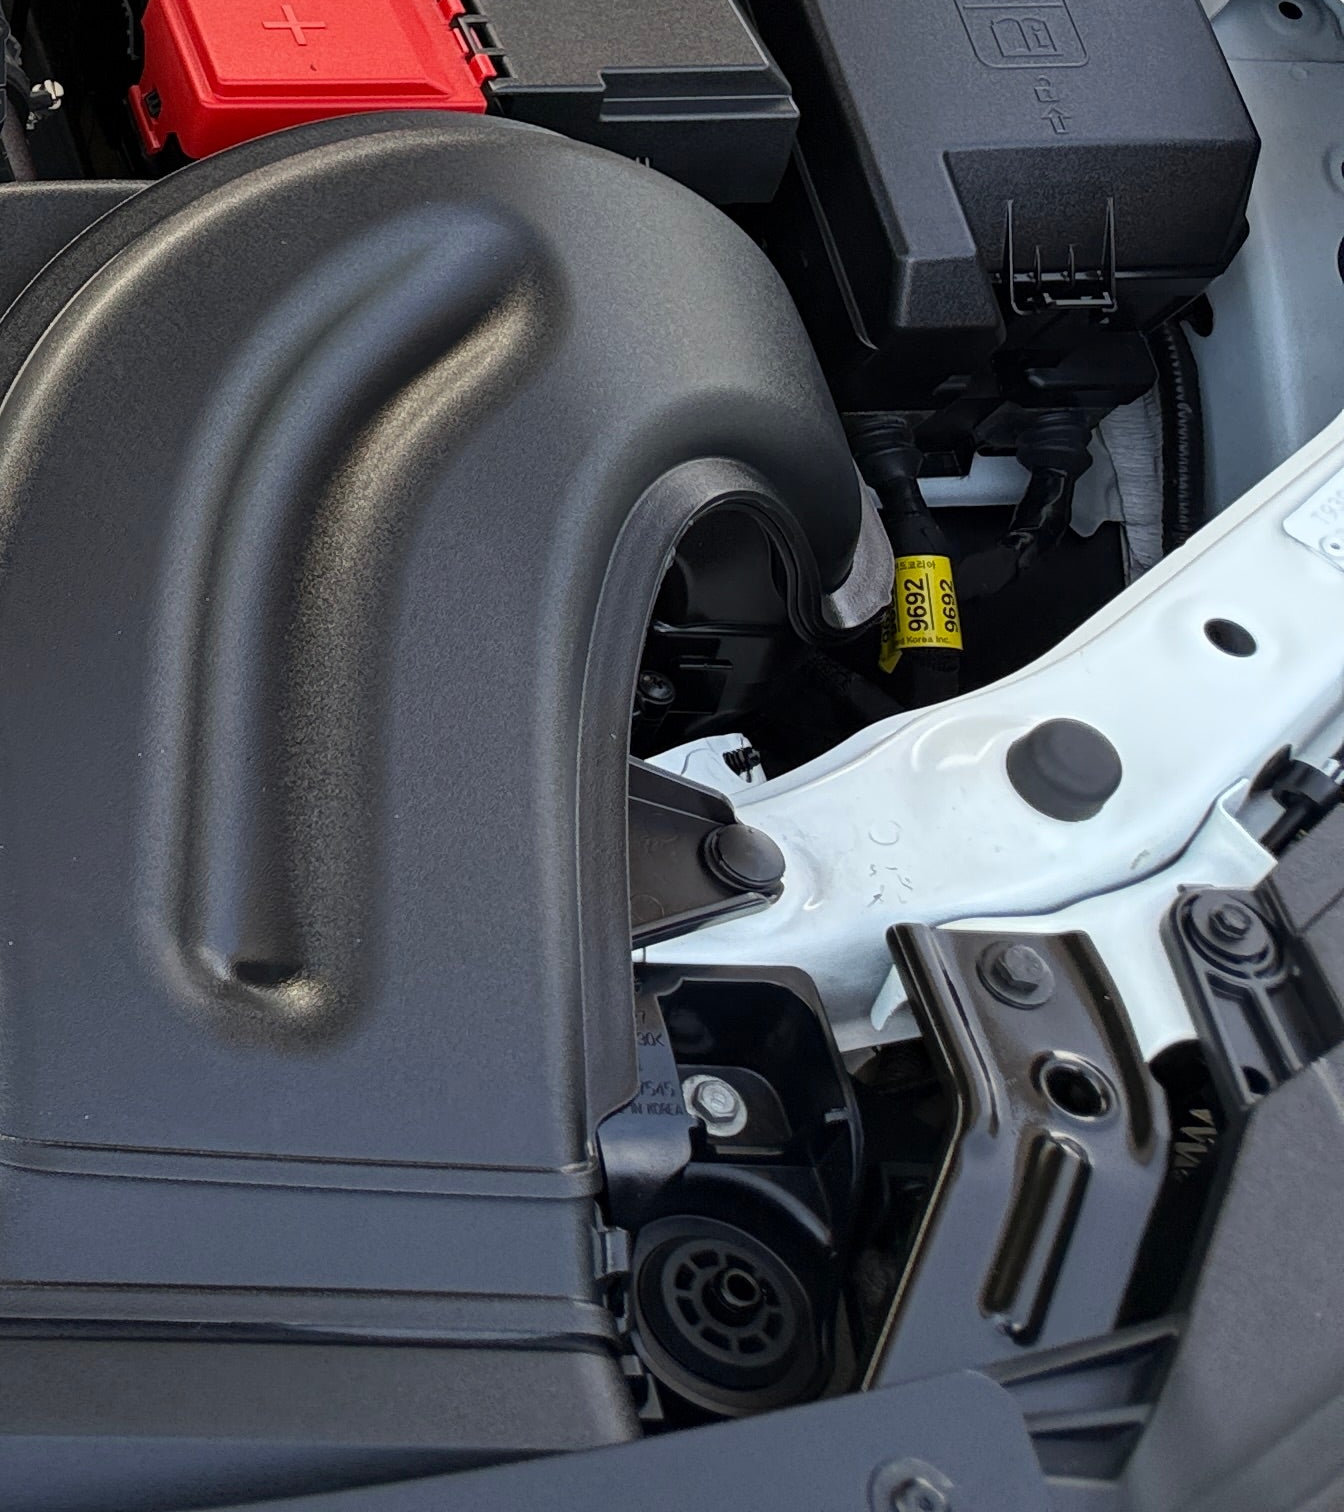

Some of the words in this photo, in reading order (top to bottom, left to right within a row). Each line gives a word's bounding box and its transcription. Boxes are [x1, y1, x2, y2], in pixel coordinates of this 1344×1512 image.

[903, 577, 929, 632] 9692
[939, 578, 959, 633] 9692
[907, 636, 933, 644] Korea
